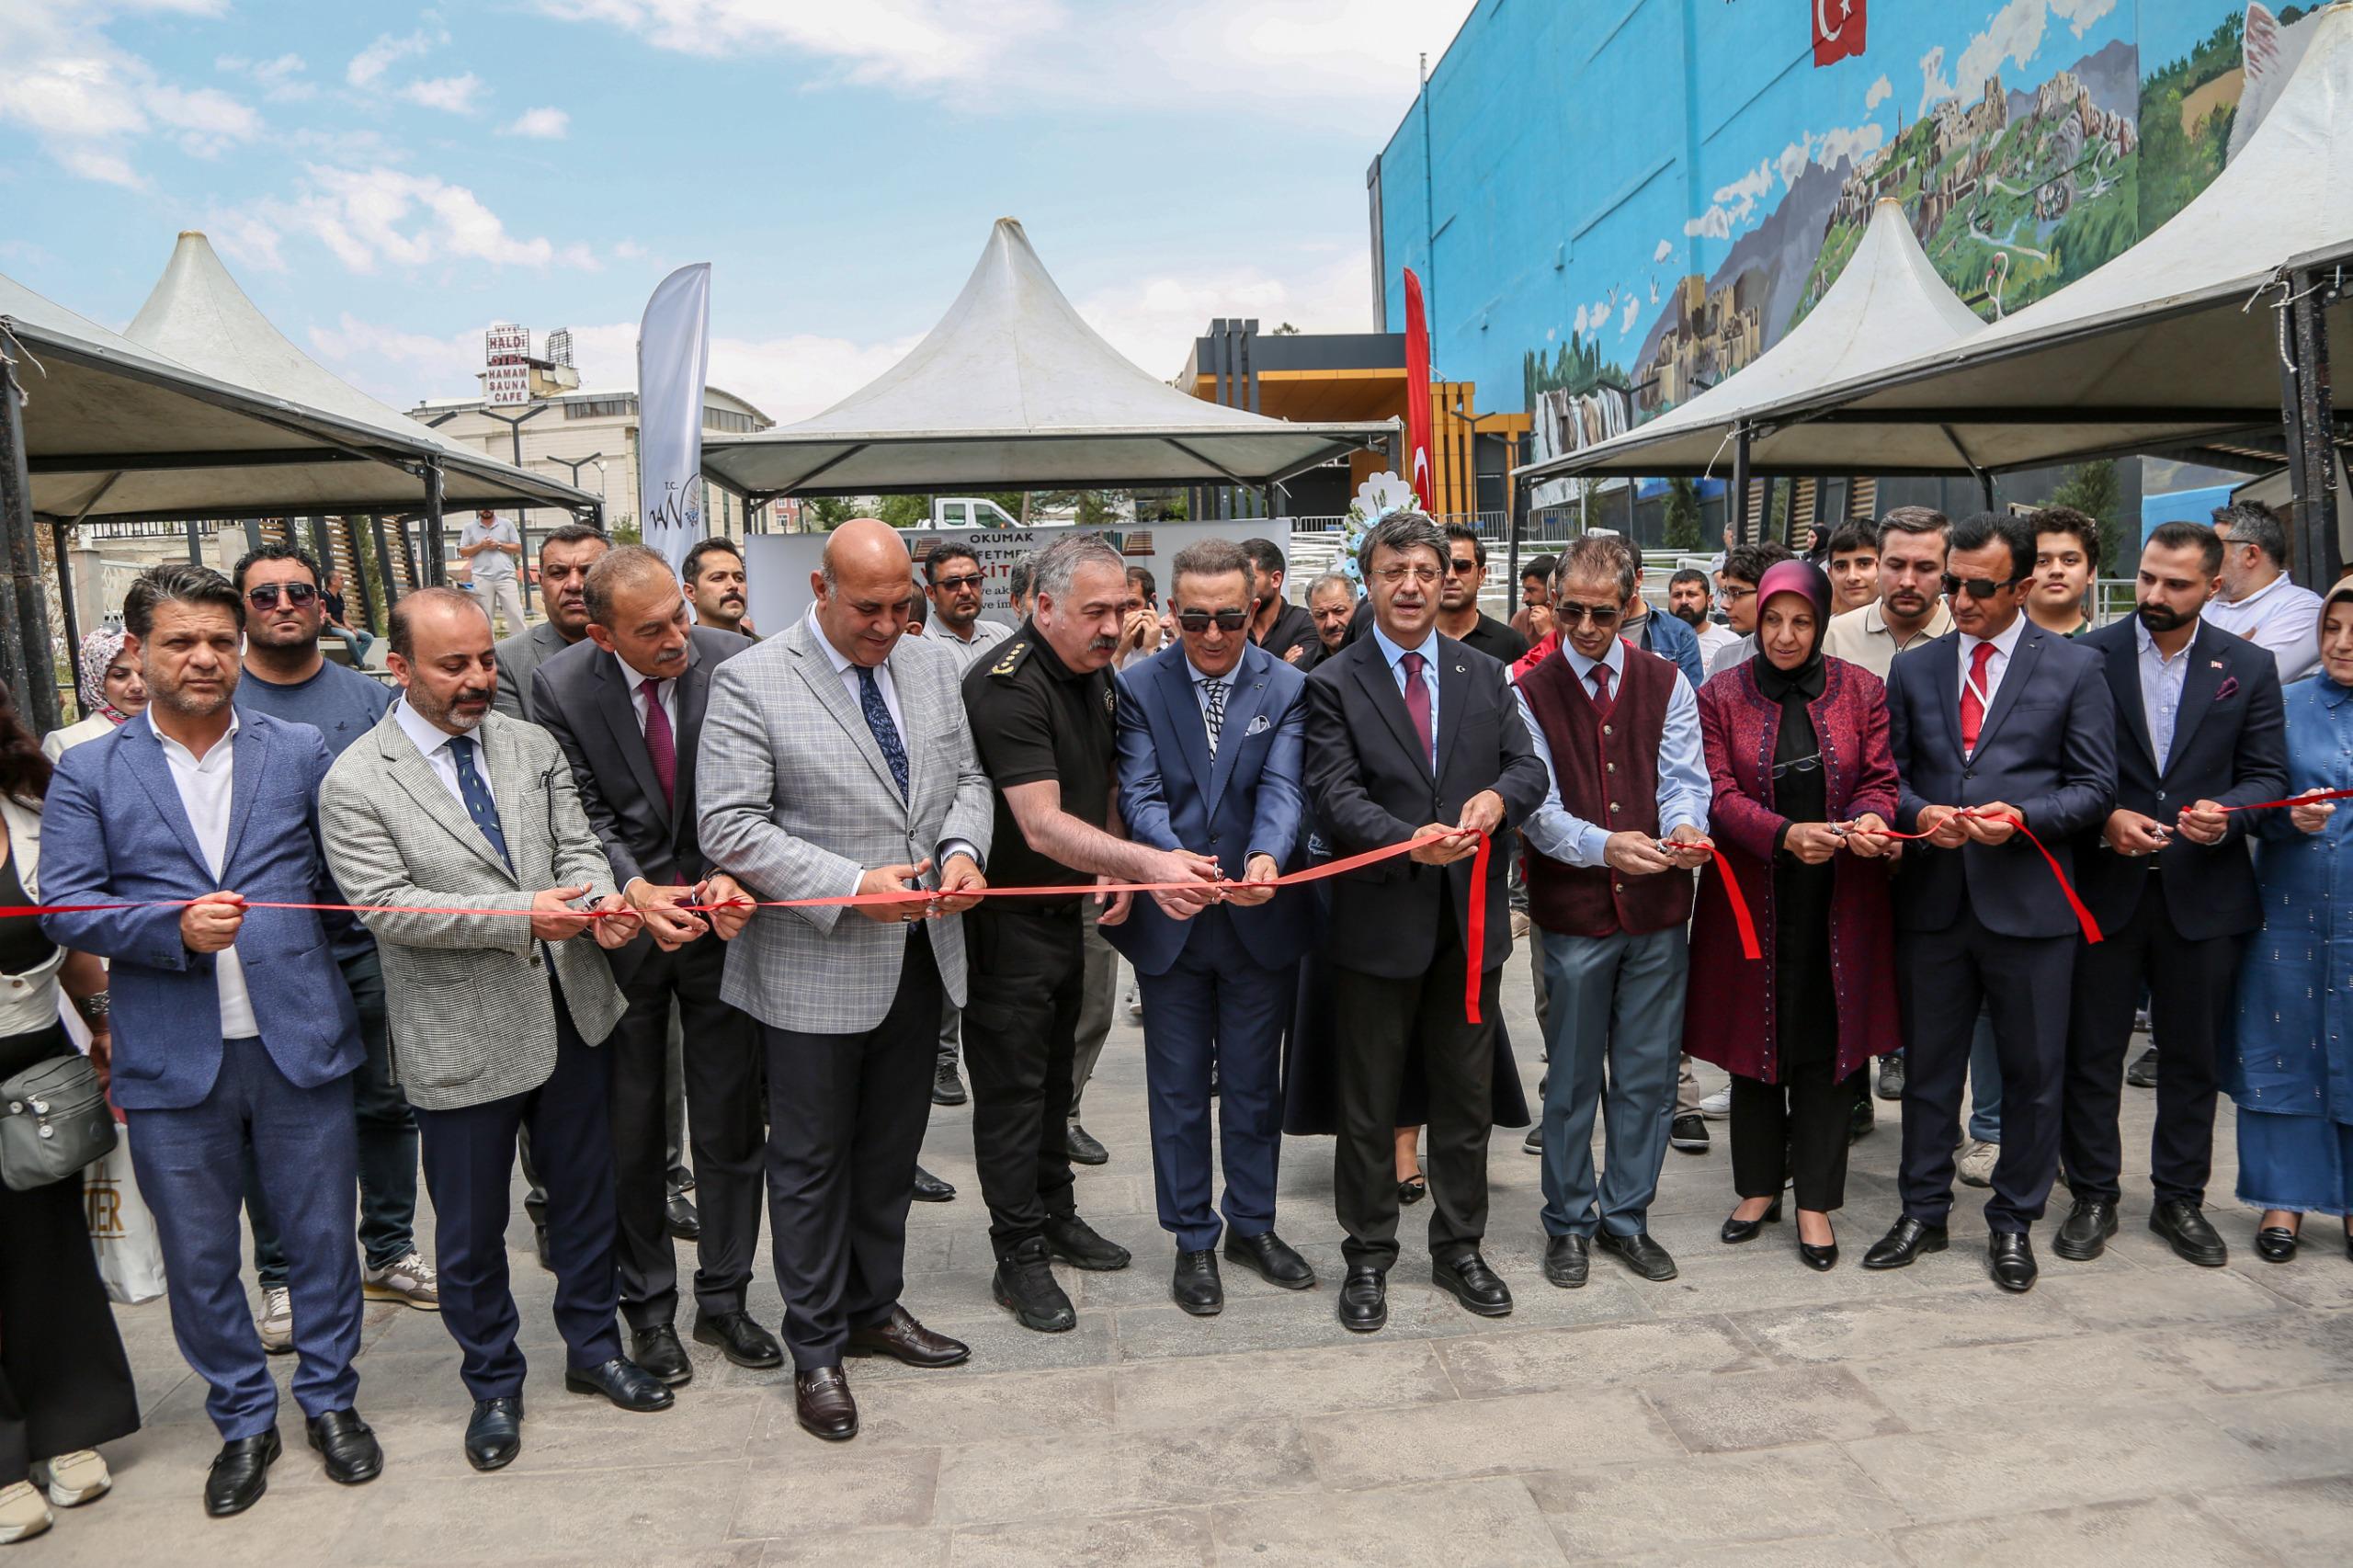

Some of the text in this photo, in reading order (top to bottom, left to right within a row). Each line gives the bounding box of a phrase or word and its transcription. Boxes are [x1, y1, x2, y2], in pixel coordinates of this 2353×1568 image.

[489, 369, 527, 379] HAMAM
[489, 381, 527, 391] SAUNA
[494, 392, 522, 402] CAFE
[665, 482, 679, 490] T.C.
[970, 533, 1034, 543] OKUMAK
